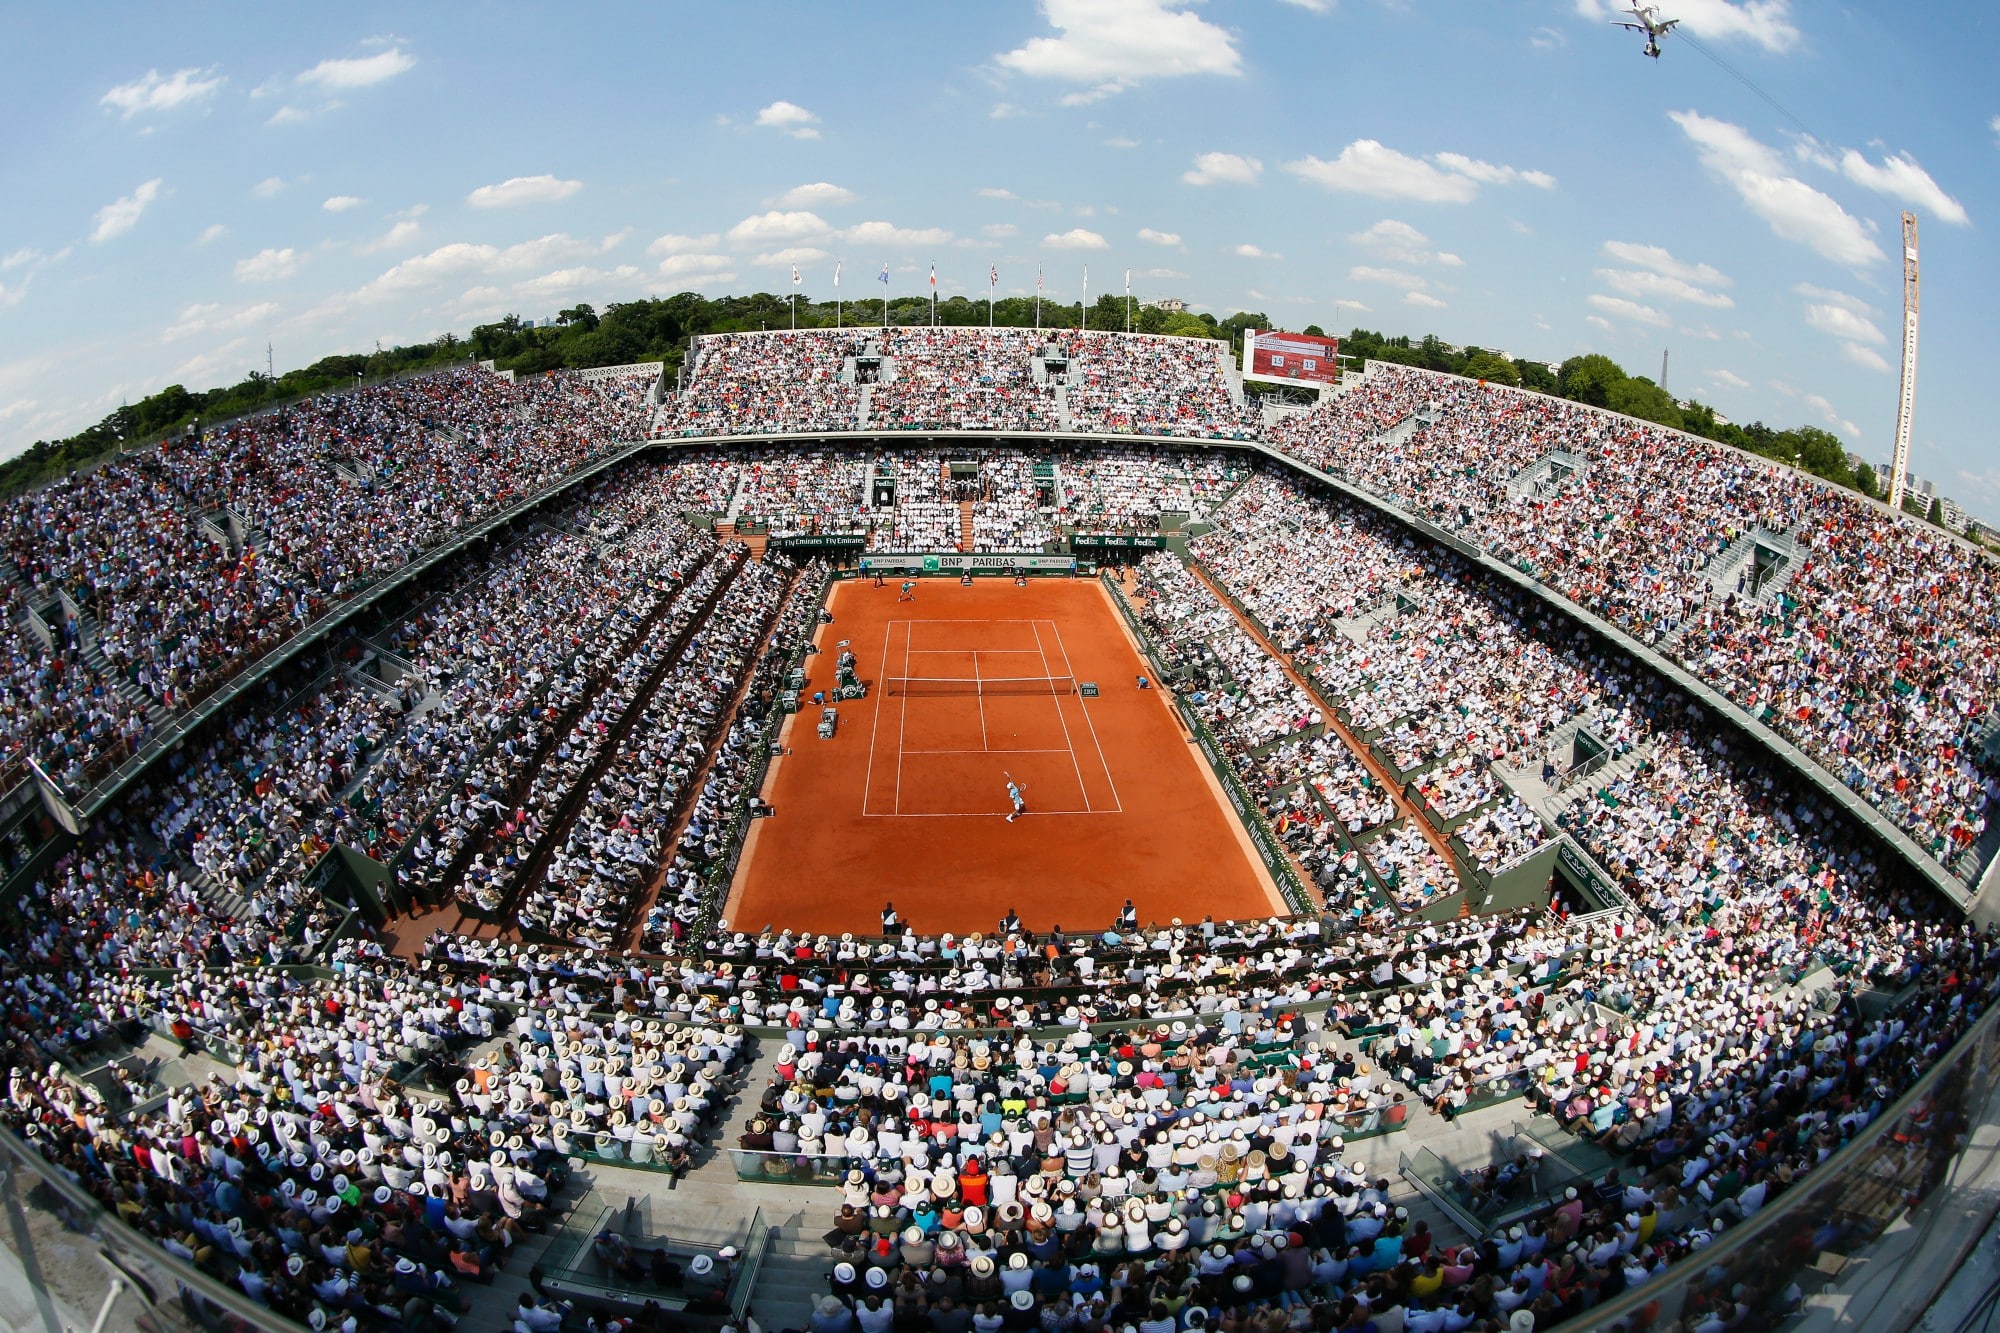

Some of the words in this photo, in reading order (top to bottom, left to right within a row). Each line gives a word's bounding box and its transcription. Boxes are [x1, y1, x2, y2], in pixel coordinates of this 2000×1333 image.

[1273, 357, 1283, 365] 15
[1305, 361, 1314, 369] 15
[826, 537, 836, 545] Fly
[1075, 536, 1098, 545] FedEx
[1105, 537, 1128, 546] FedEx
[1134, 538, 1157, 546] FedEx
[941, 558, 962, 566] BNP
[973, 558, 1016, 566] PARIBAS
[1222, 775, 1231, 791] Fly
[1227, 787, 1246, 816] Emirates
[1248, 820, 1257, 838] Fly
[1255, 834, 1275, 868] Emirates
[1277, 871, 1288, 892] Fly
